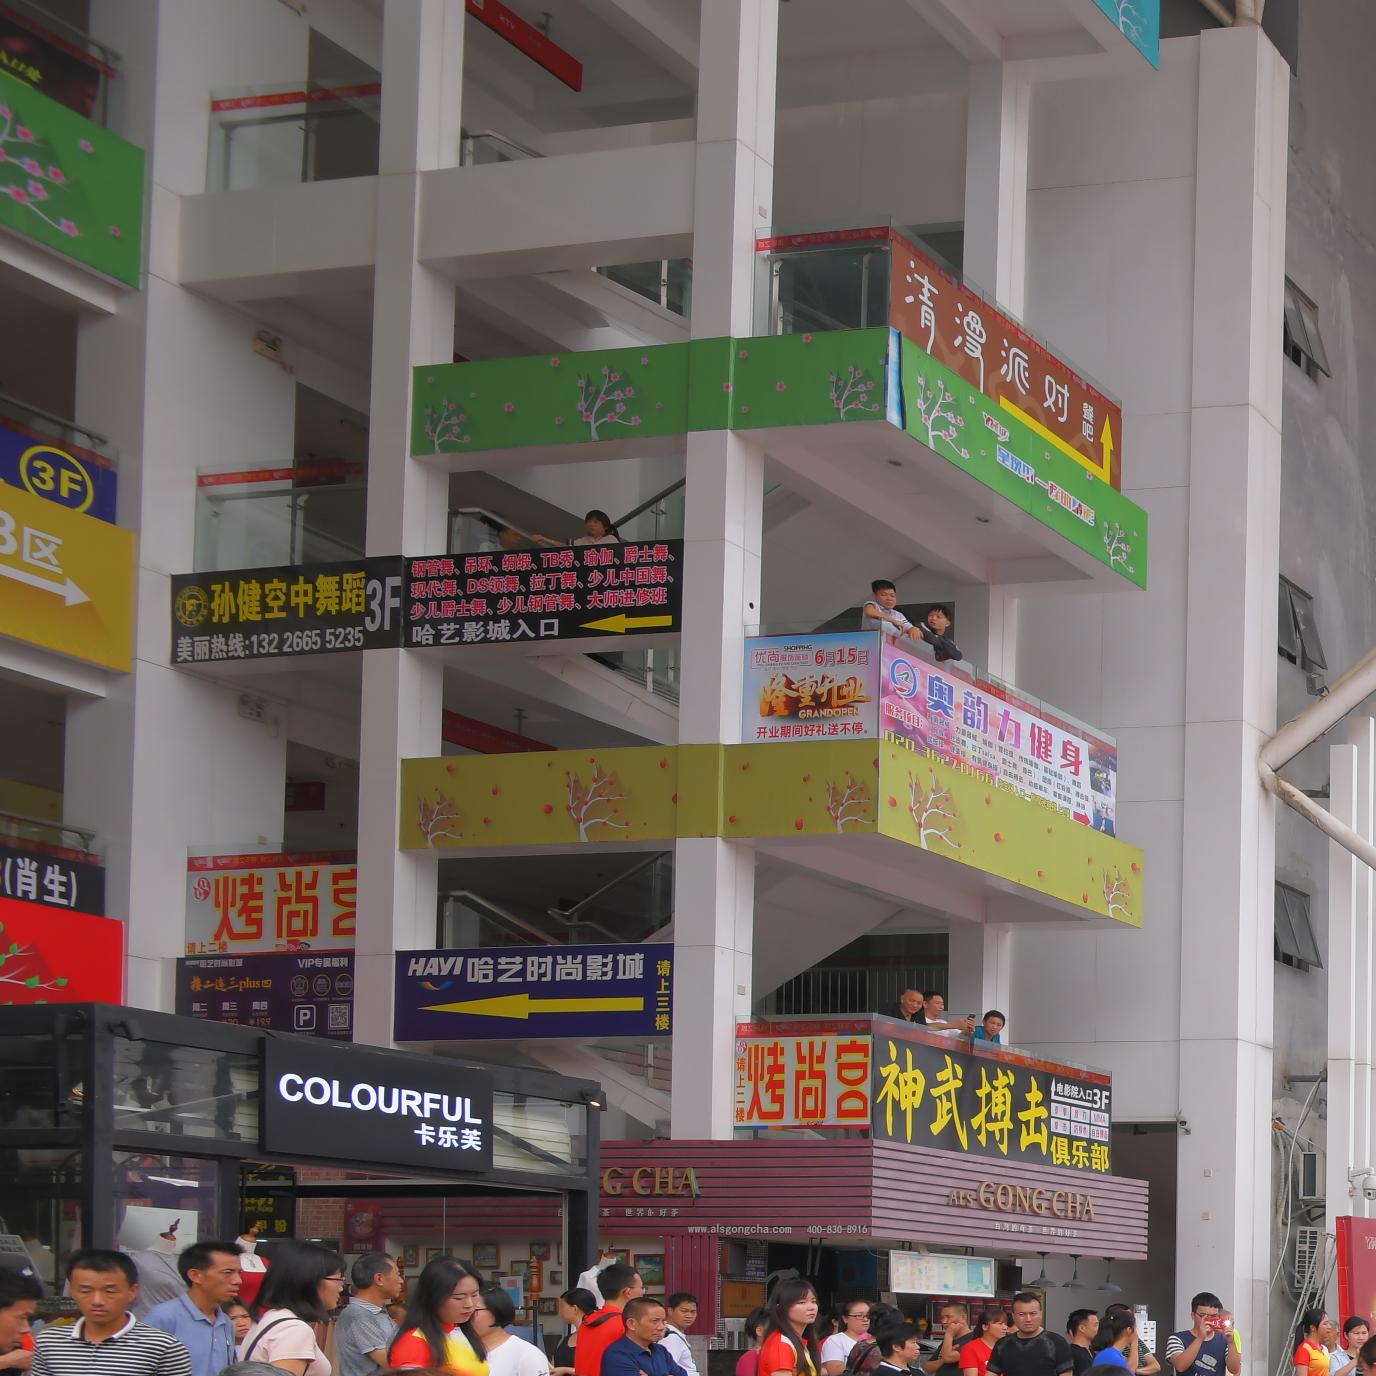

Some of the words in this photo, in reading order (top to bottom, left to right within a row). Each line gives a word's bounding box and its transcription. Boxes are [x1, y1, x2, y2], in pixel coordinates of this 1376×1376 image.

[31, 459, 82, 498] 3F
[210, 571, 366, 623] 孙健空中舞蹈
[364, 576, 402, 632] 3F
[283, 630, 322, 653] 2665
[325, 626, 364, 648] 5235
[411, 619, 560, 645] 哈艺影城入口
[814, 648, 870, 666] 6月15日
[756, 722, 869, 739] 开业期间好礼送不停。
[927, 674, 1083, 777] 奥韵力健身
[407, 956, 466, 976] HAYI
[466, 952, 645, 984] 哈艺时尚影城
[655, 959, 670, 1030] 请上三楼
[279, 1073, 482, 1124] COLOURFUL
[735, 1058, 746, 1122] 请上二楼
[876, 1040, 1050, 1156] 神武搏击
[414, 1123, 482, 1151] 卡乐芙
[1050, 1135, 1110, 1172] 俱乐部
[977, 1180, 1049, 1216] GONG
[1051, 1191, 1096, 1221] CHA
[688, 1222, 793, 1238] www.alsgongcha.com
[806, 1223, 869, 1235] 400-830-8916
